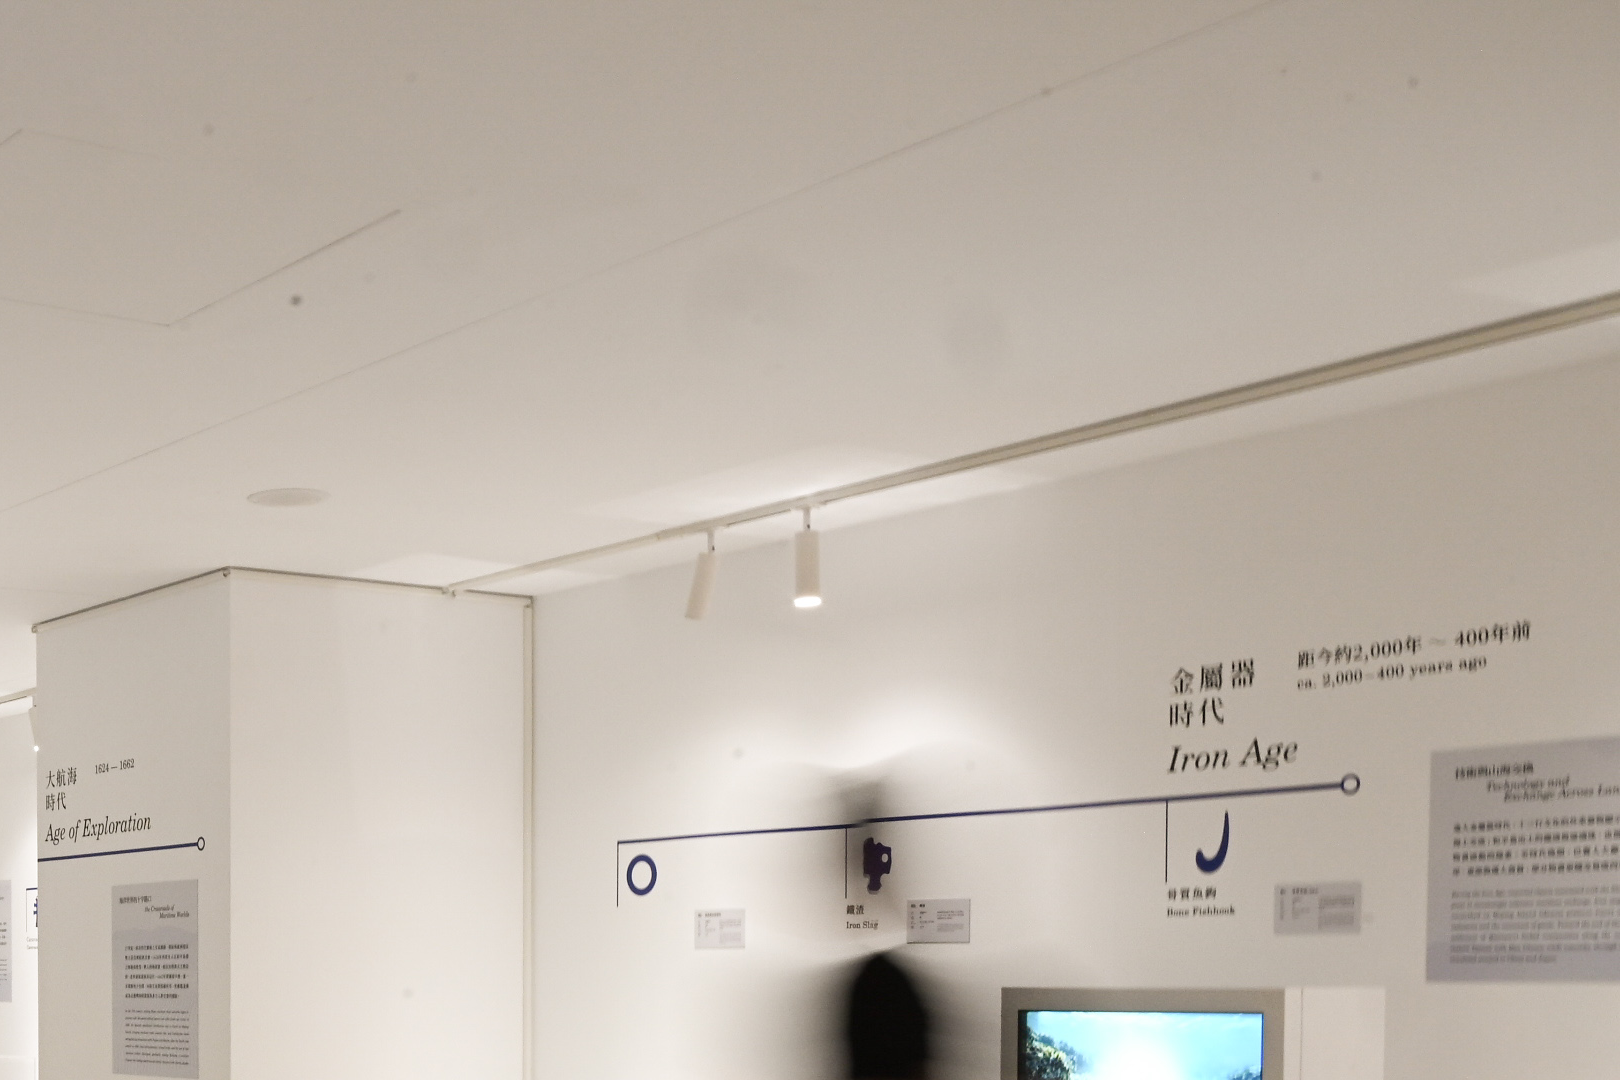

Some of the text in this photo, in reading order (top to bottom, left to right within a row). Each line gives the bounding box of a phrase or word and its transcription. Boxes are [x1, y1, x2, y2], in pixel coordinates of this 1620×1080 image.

[1455, 619, 1530, 648] 400年前
[1171, 657, 1255, 695] 金屬器
[1409, 659, 1453, 681] years
[1459, 655, 1487, 672] ago
[1168, 697, 1225, 729] 時代
[94, 763, 110, 774] 1624
[119, 758, 135, 770] 1662
[1167, 736, 1299, 775] Iron Age
[46, 766, 77, 789] 大航海
[45, 792, 67, 811] 時代
[44, 812, 152, 846] Age of Exploration
[1192, 904, 1236, 918] Fishhook
[846, 919, 879, 931] Iron Slag
